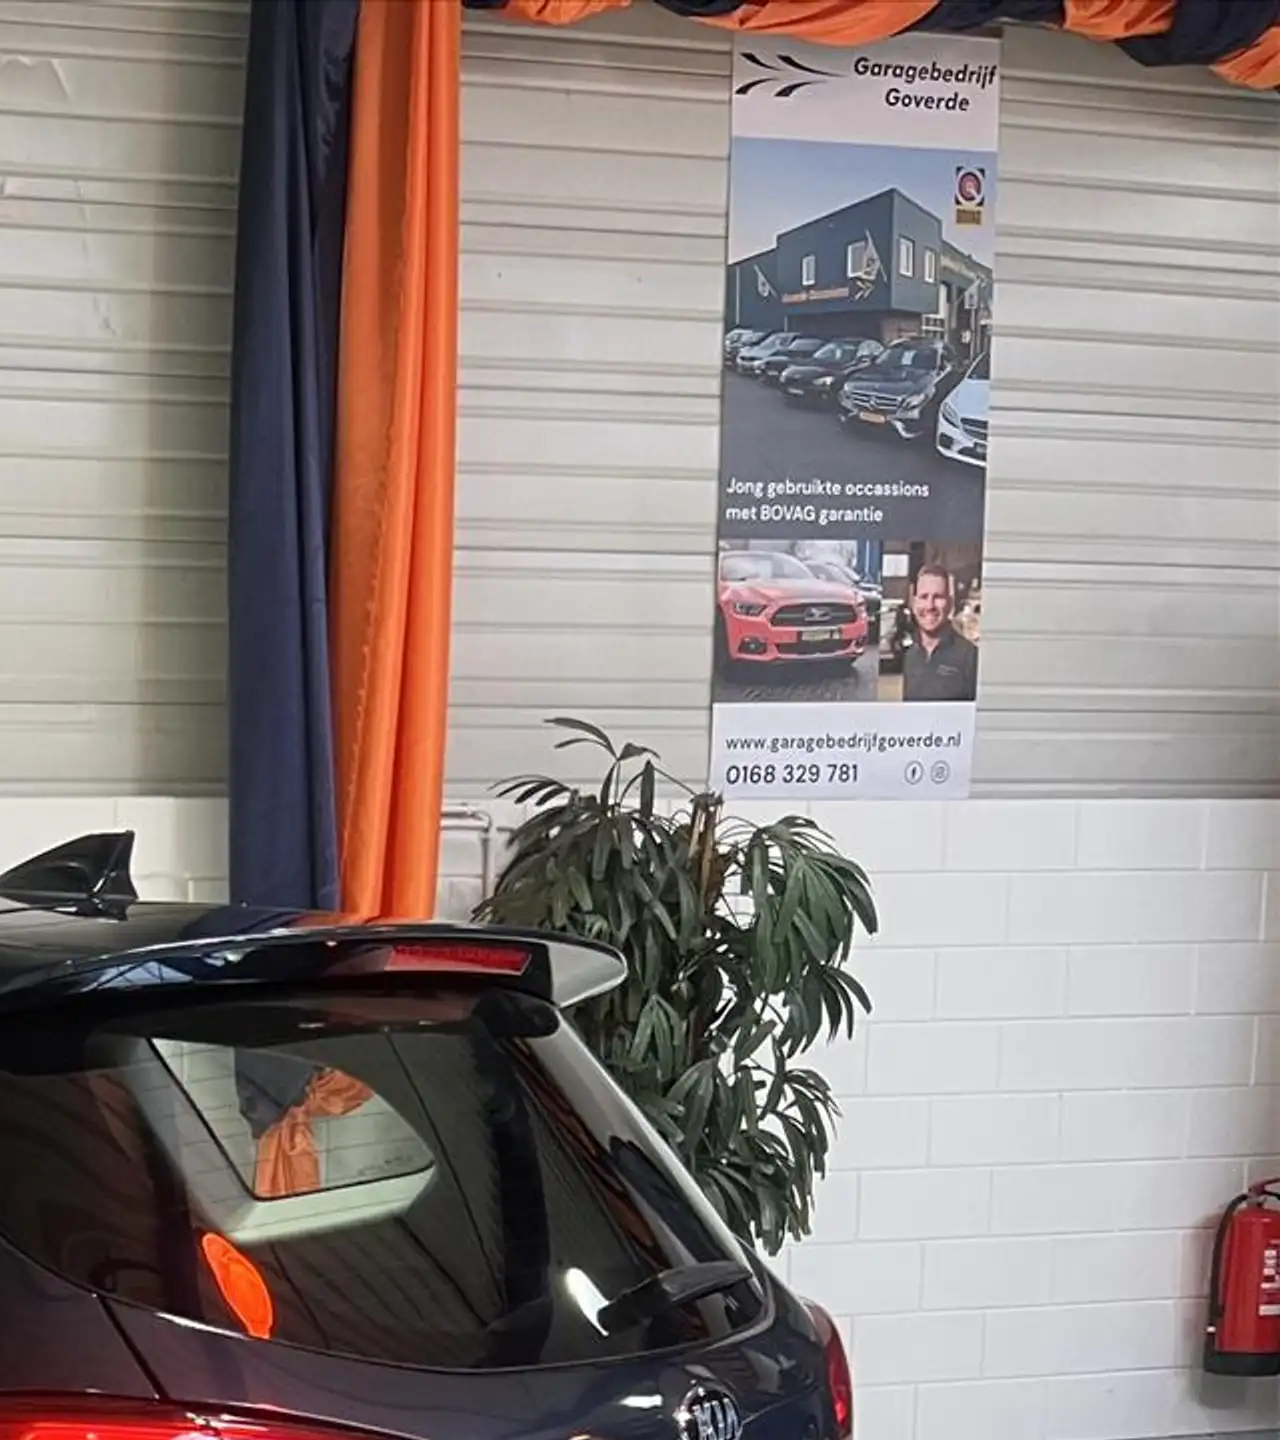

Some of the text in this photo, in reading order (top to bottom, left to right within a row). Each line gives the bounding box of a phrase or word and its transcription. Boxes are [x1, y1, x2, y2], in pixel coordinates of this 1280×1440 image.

[853, 57, 998, 88] Garagebedrijf
[885, 88, 970, 111] Goverde
[726, 477, 763, 498] Jong
[767, 478, 841, 498] gebruikte
[725, 504, 883, 525] met BOVAG garantie
[726, 731, 961, 752] www.garagebedrijfgoverde.nl
[726, 763, 858, 784] 0168 329 781
